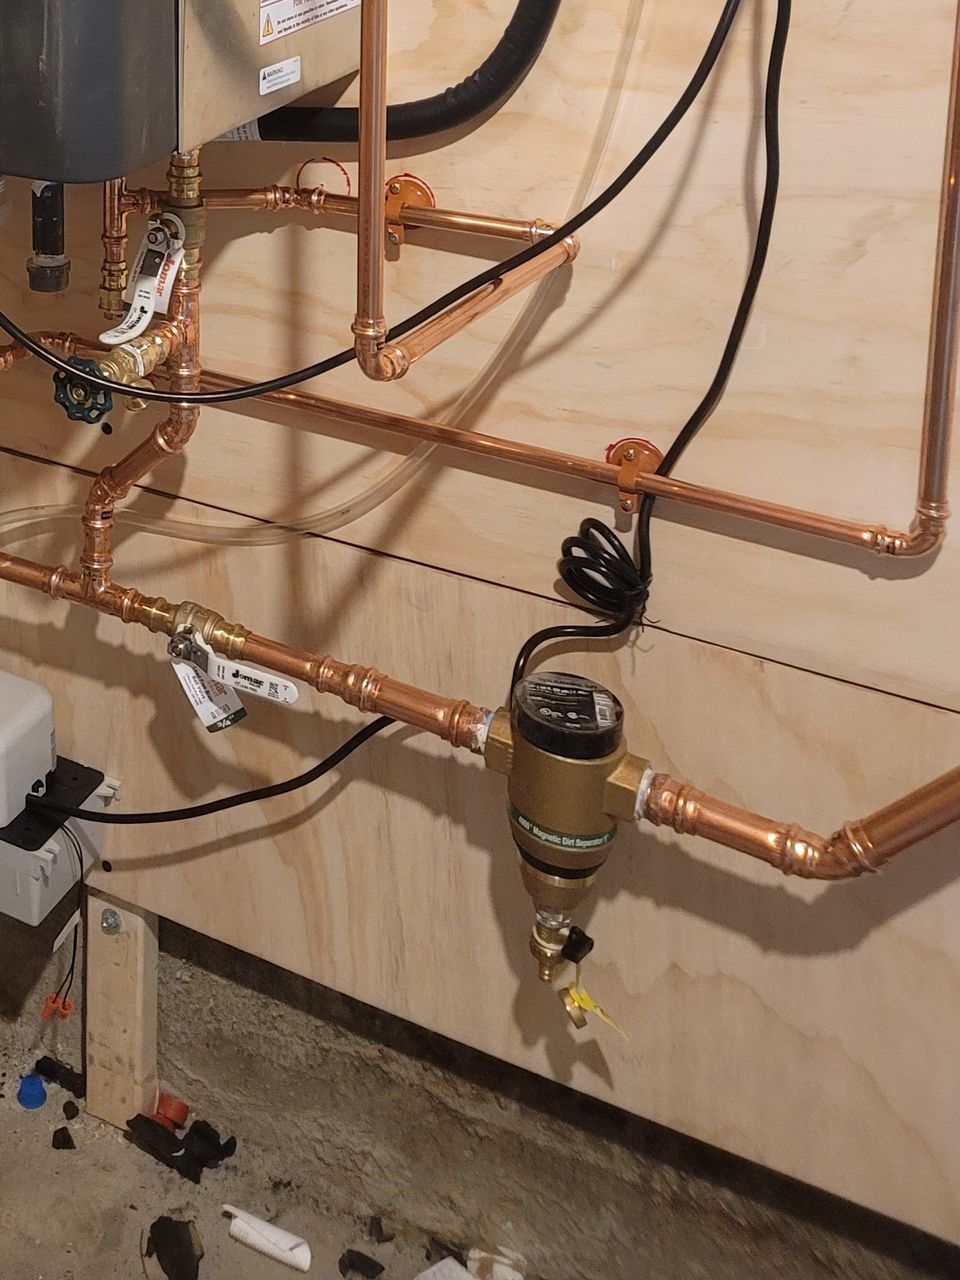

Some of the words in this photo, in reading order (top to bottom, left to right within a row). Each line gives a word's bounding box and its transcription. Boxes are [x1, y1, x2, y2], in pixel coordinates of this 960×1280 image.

[231, 669, 265, 687] Jomar
[532, 825, 562, 844] Magnetic
[561, 836, 576, 846] Dirt
[575, 838, 603, 849] Separator
